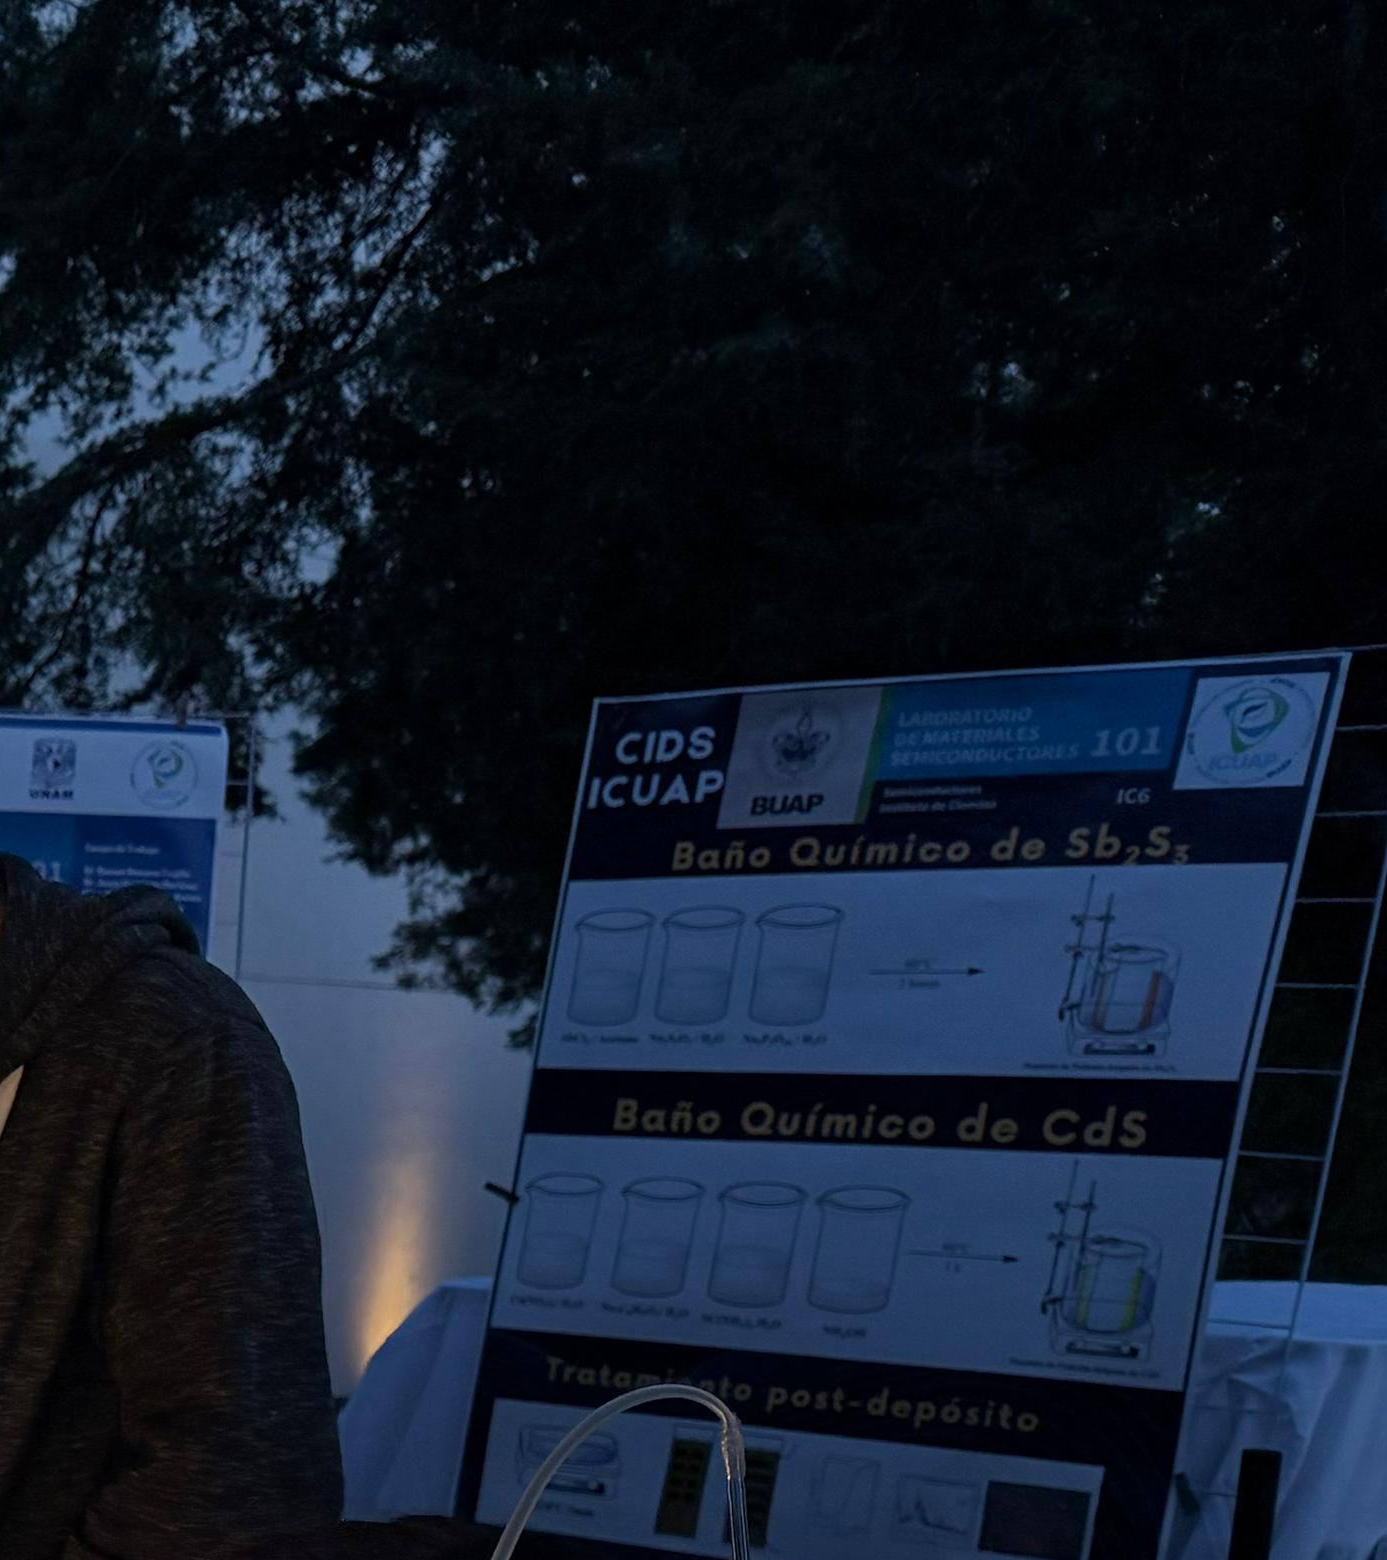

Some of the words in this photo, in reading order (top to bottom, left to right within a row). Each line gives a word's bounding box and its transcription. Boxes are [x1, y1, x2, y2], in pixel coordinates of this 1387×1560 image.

[898, 706, 1033, 728] LABORATORIO
[923, 725, 1040, 745] MATERIALES
[614, 726, 716, 765] CIDS
[1090, 725, 1162, 758] 101
[30, 789, 74, 800] UNAM
[586, 769, 725, 810] ICUAP
[749, 795, 823, 816] BUAP
[671, 840, 771, 871] Baño
[789, 831, 971, 867] Químico
[989, 825, 1047, 862] de
[613, 1096, 722, 1135] Baño
[739, 1100, 934, 1141] Químico
[954, 1106, 1018, 1145] de
[1038, 1109, 1147, 1148] CdS
[545, 1356, 755, 1403] Tratamito
[767, 1383, 1042, 1435] post-depósito
